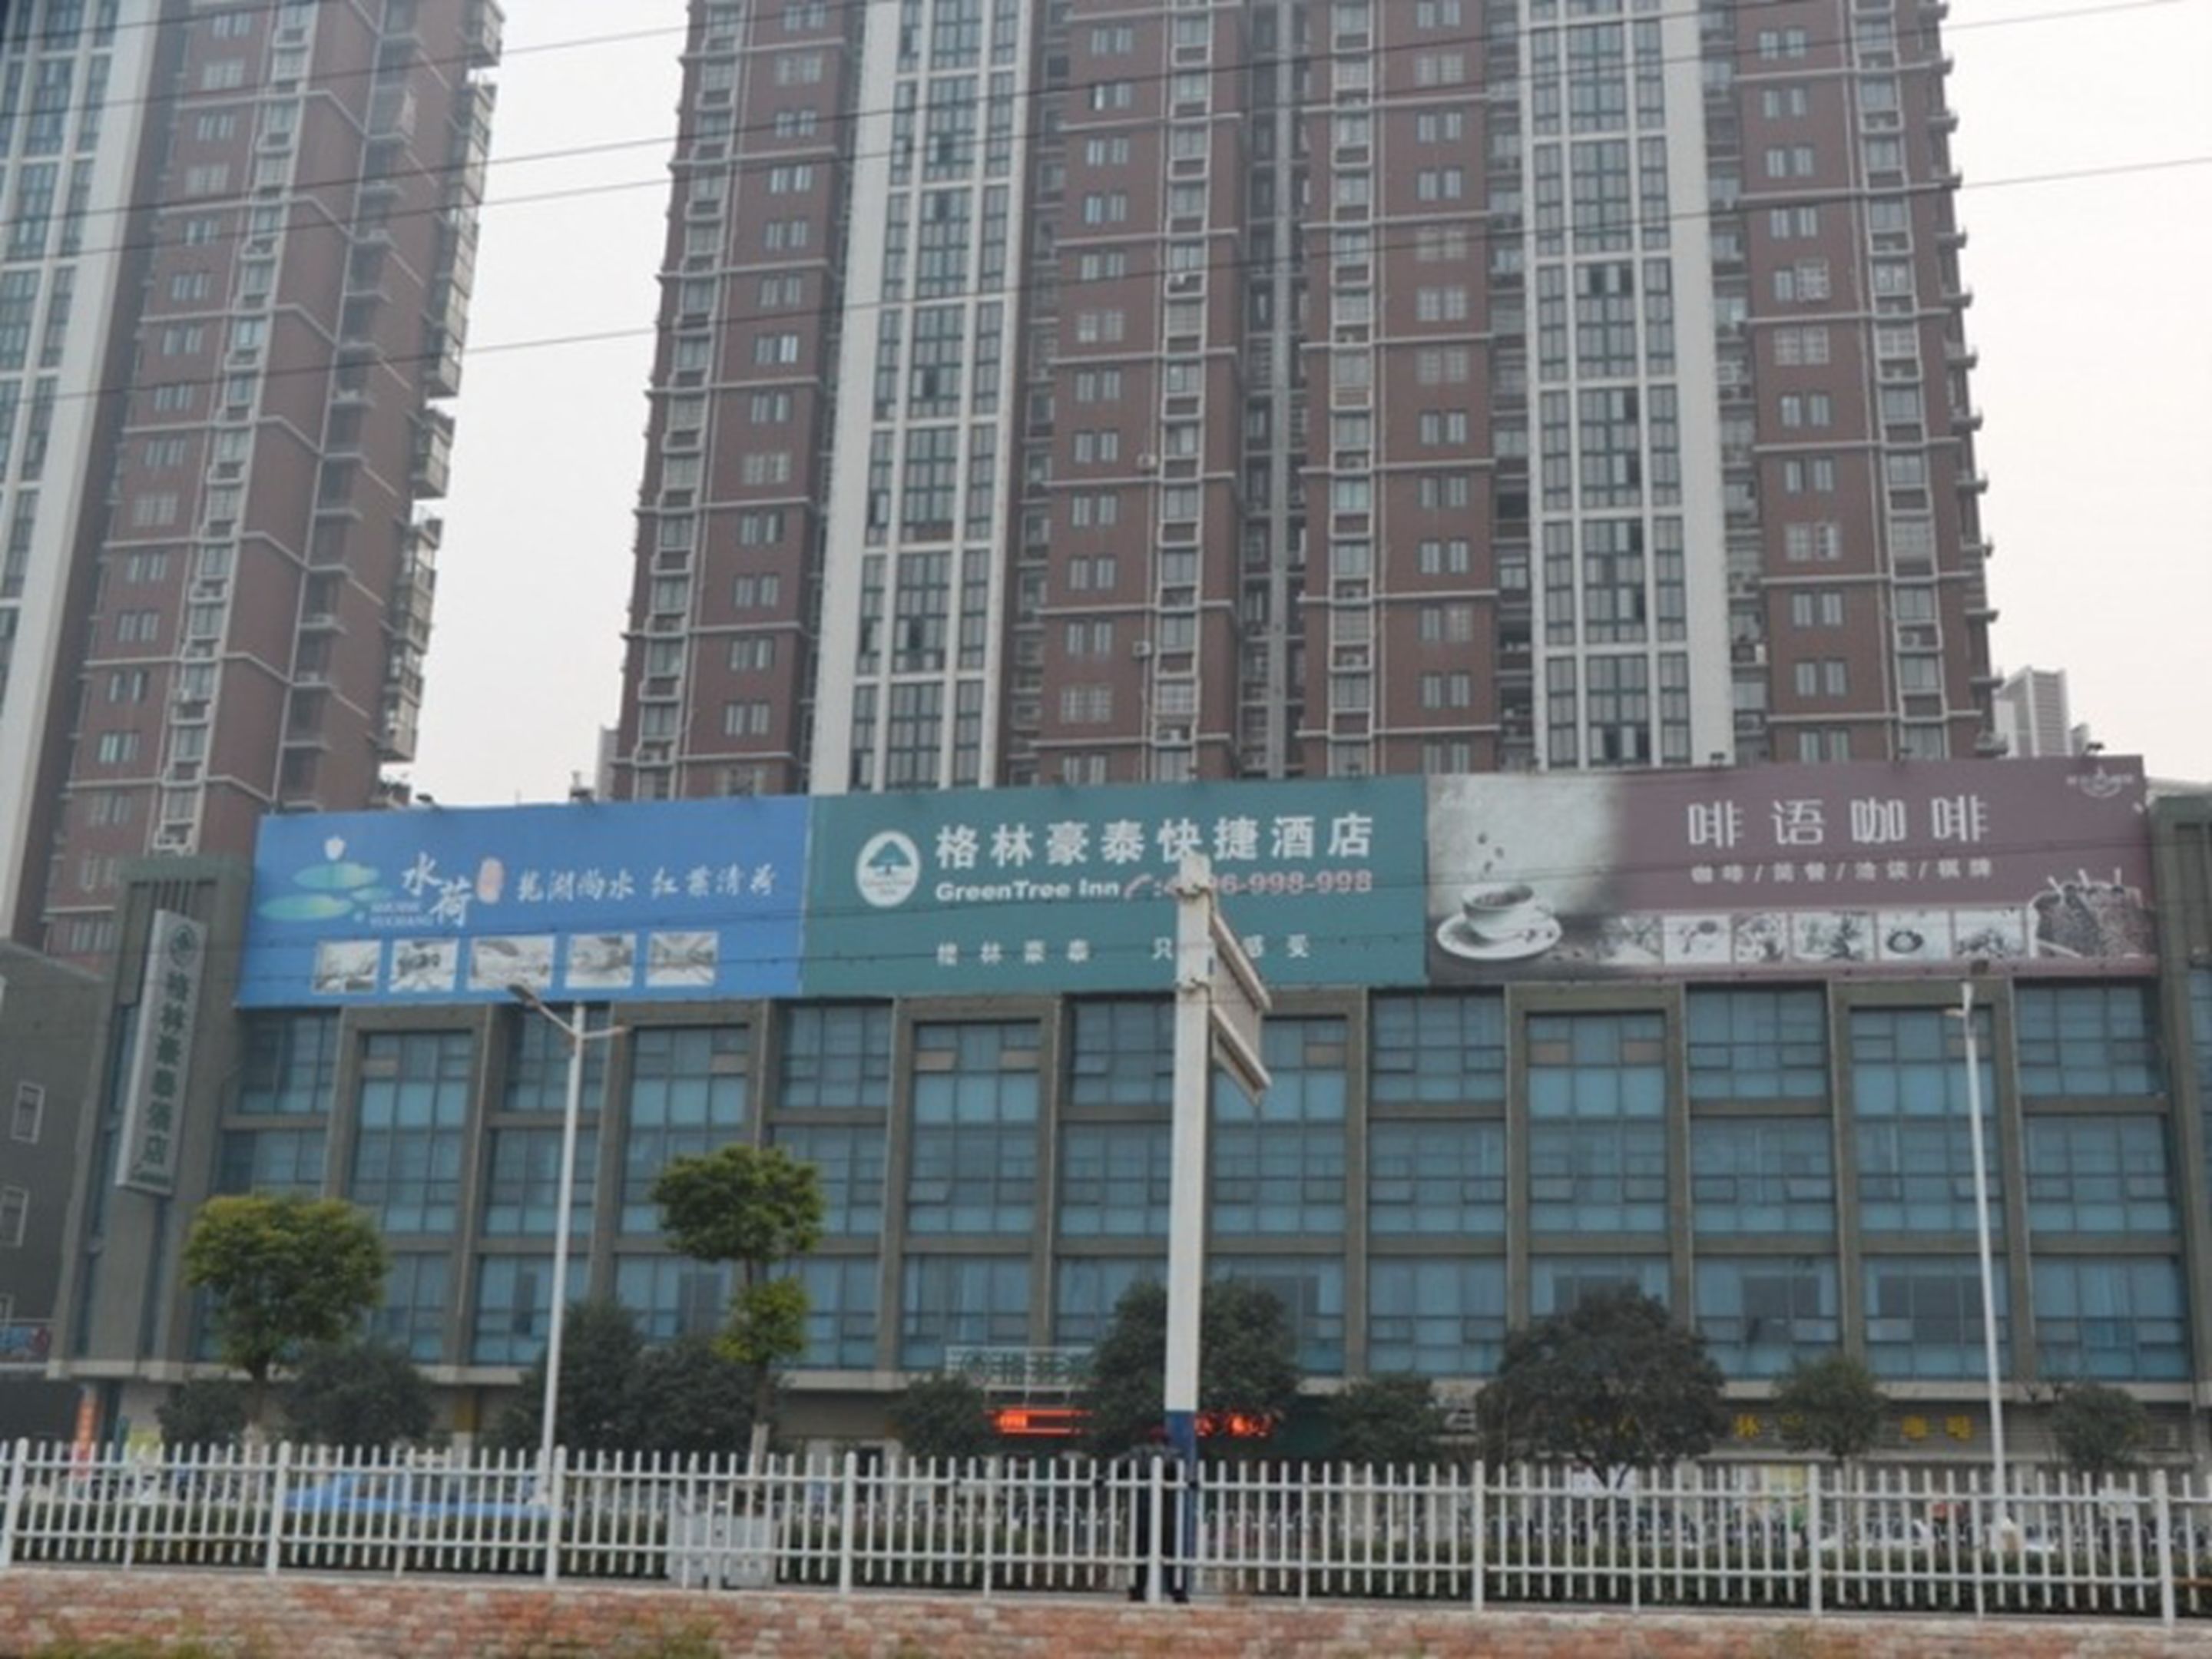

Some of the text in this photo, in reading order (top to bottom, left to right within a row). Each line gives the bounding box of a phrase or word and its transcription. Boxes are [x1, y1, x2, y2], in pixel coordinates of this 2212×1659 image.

[1688, 794, 1988, 846] 啡语咖啡
[935, 813, 1373, 869] 格林豪泰快捷酒店
[935, 879, 1071, 901] GreenTree
[1078, 877, 1119, 897] Inn
[1152, 934, 1309, 960] 只感受
